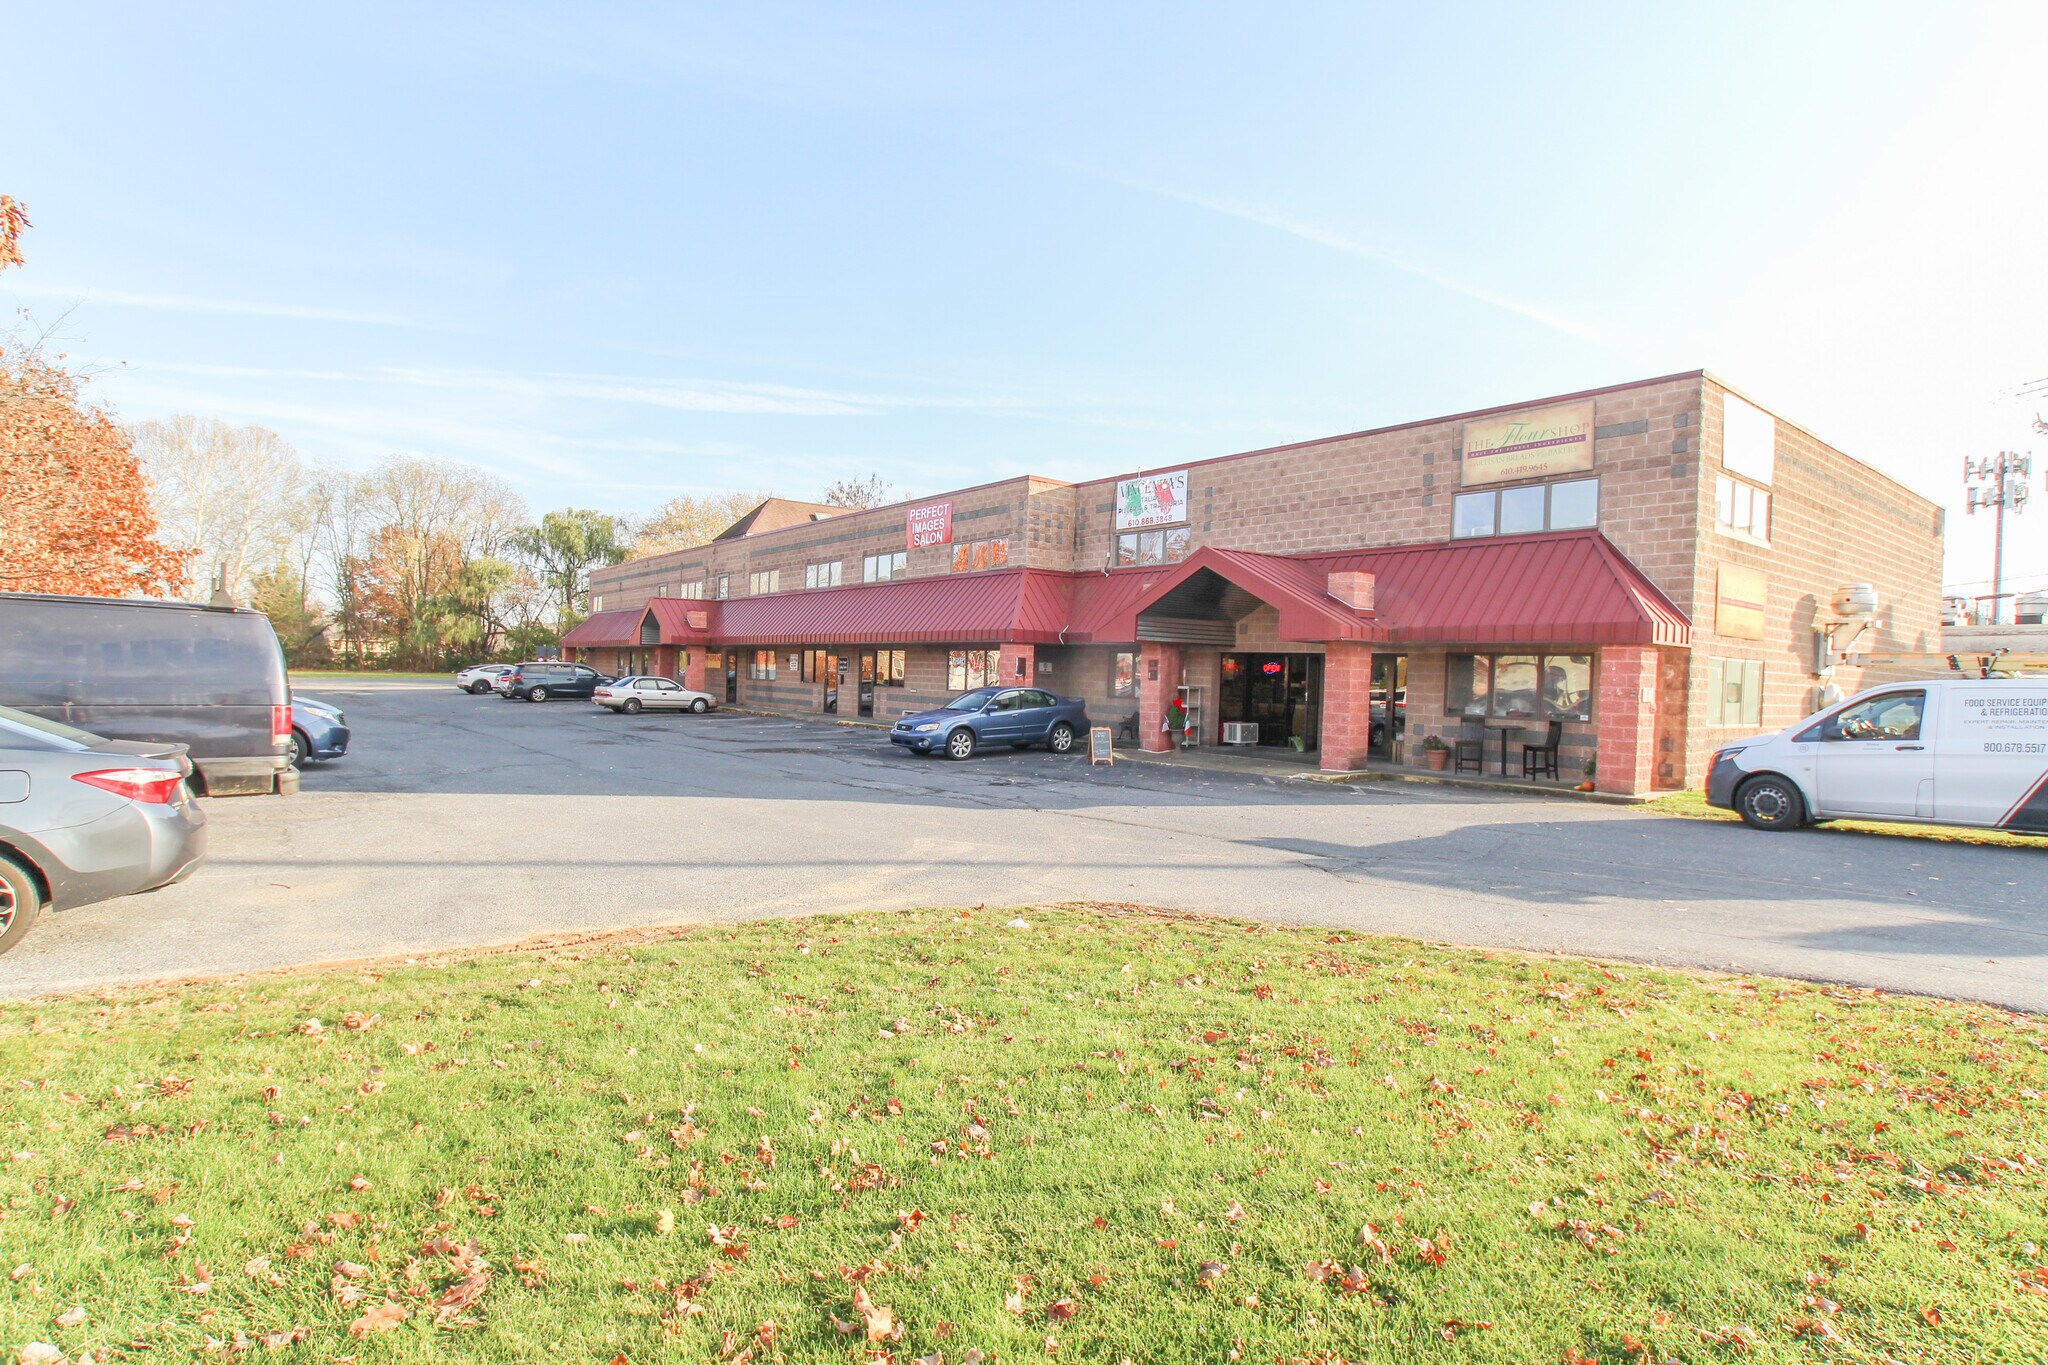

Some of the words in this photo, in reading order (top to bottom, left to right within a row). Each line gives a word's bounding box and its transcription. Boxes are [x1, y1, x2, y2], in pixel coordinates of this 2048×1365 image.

[1467, 439, 1491, 451] THE
[1491, 422, 1548, 449] Flour
[1550, 423, 1589, 437] SHOP
[1534, 436, 1582, 447] INGREDIENTS
[1474, 456, 1505, 467] ARTISAN
[1506, 451, 1535, 461] BREADS
[1548, 446, 1578, 456] BAKERY
[1500, 463, 1548, 475] 610.419.9645
[909, 503, 949, 521] PERFECT
[912, 518, 945, 534] IMAGES
[913, 531, 943, 546] SALON
[1263, 664, 1281, 673] OPEN
[1964, 699, 1985, 707] FOOD
[1987, 698, 2019, 707] SERVICE
[1980, 708, 1987, 716] &
[1983, 743, 2047, 753] 800.678.5517
